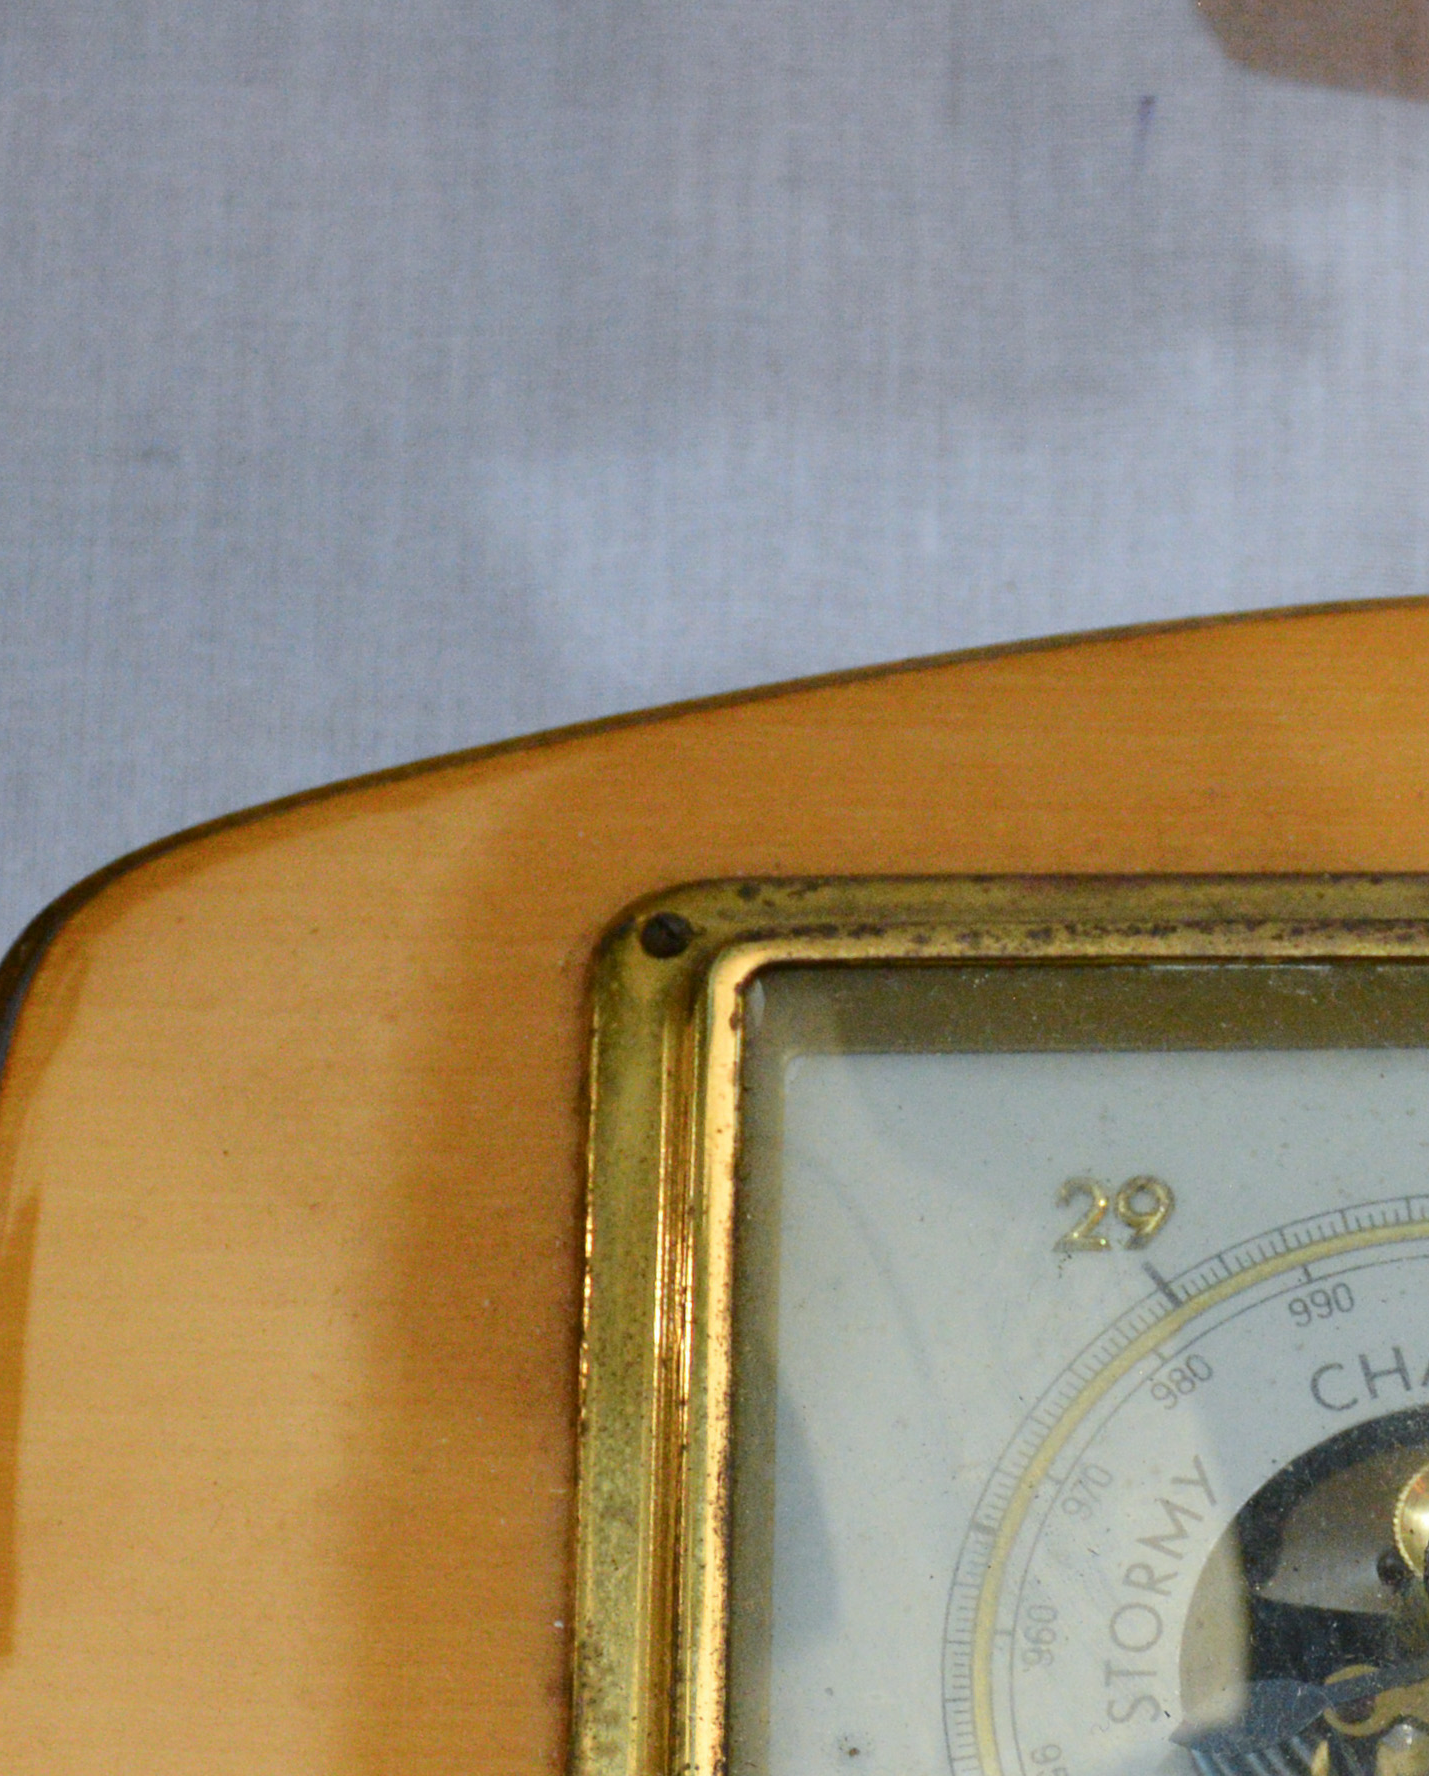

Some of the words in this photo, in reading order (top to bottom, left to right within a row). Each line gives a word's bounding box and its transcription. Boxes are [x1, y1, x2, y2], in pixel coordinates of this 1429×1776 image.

[1053, 1175, 1177, 1252] 29
[1288, 1282, 1356, 1329] 990
[1149, 1353, 1214, 1412] 980
[1061, 1463, 1114, 1522] 970
[1106, 1456, 1218, 1724] STORMY
[1022, 1603, 1060, 1668] 960
